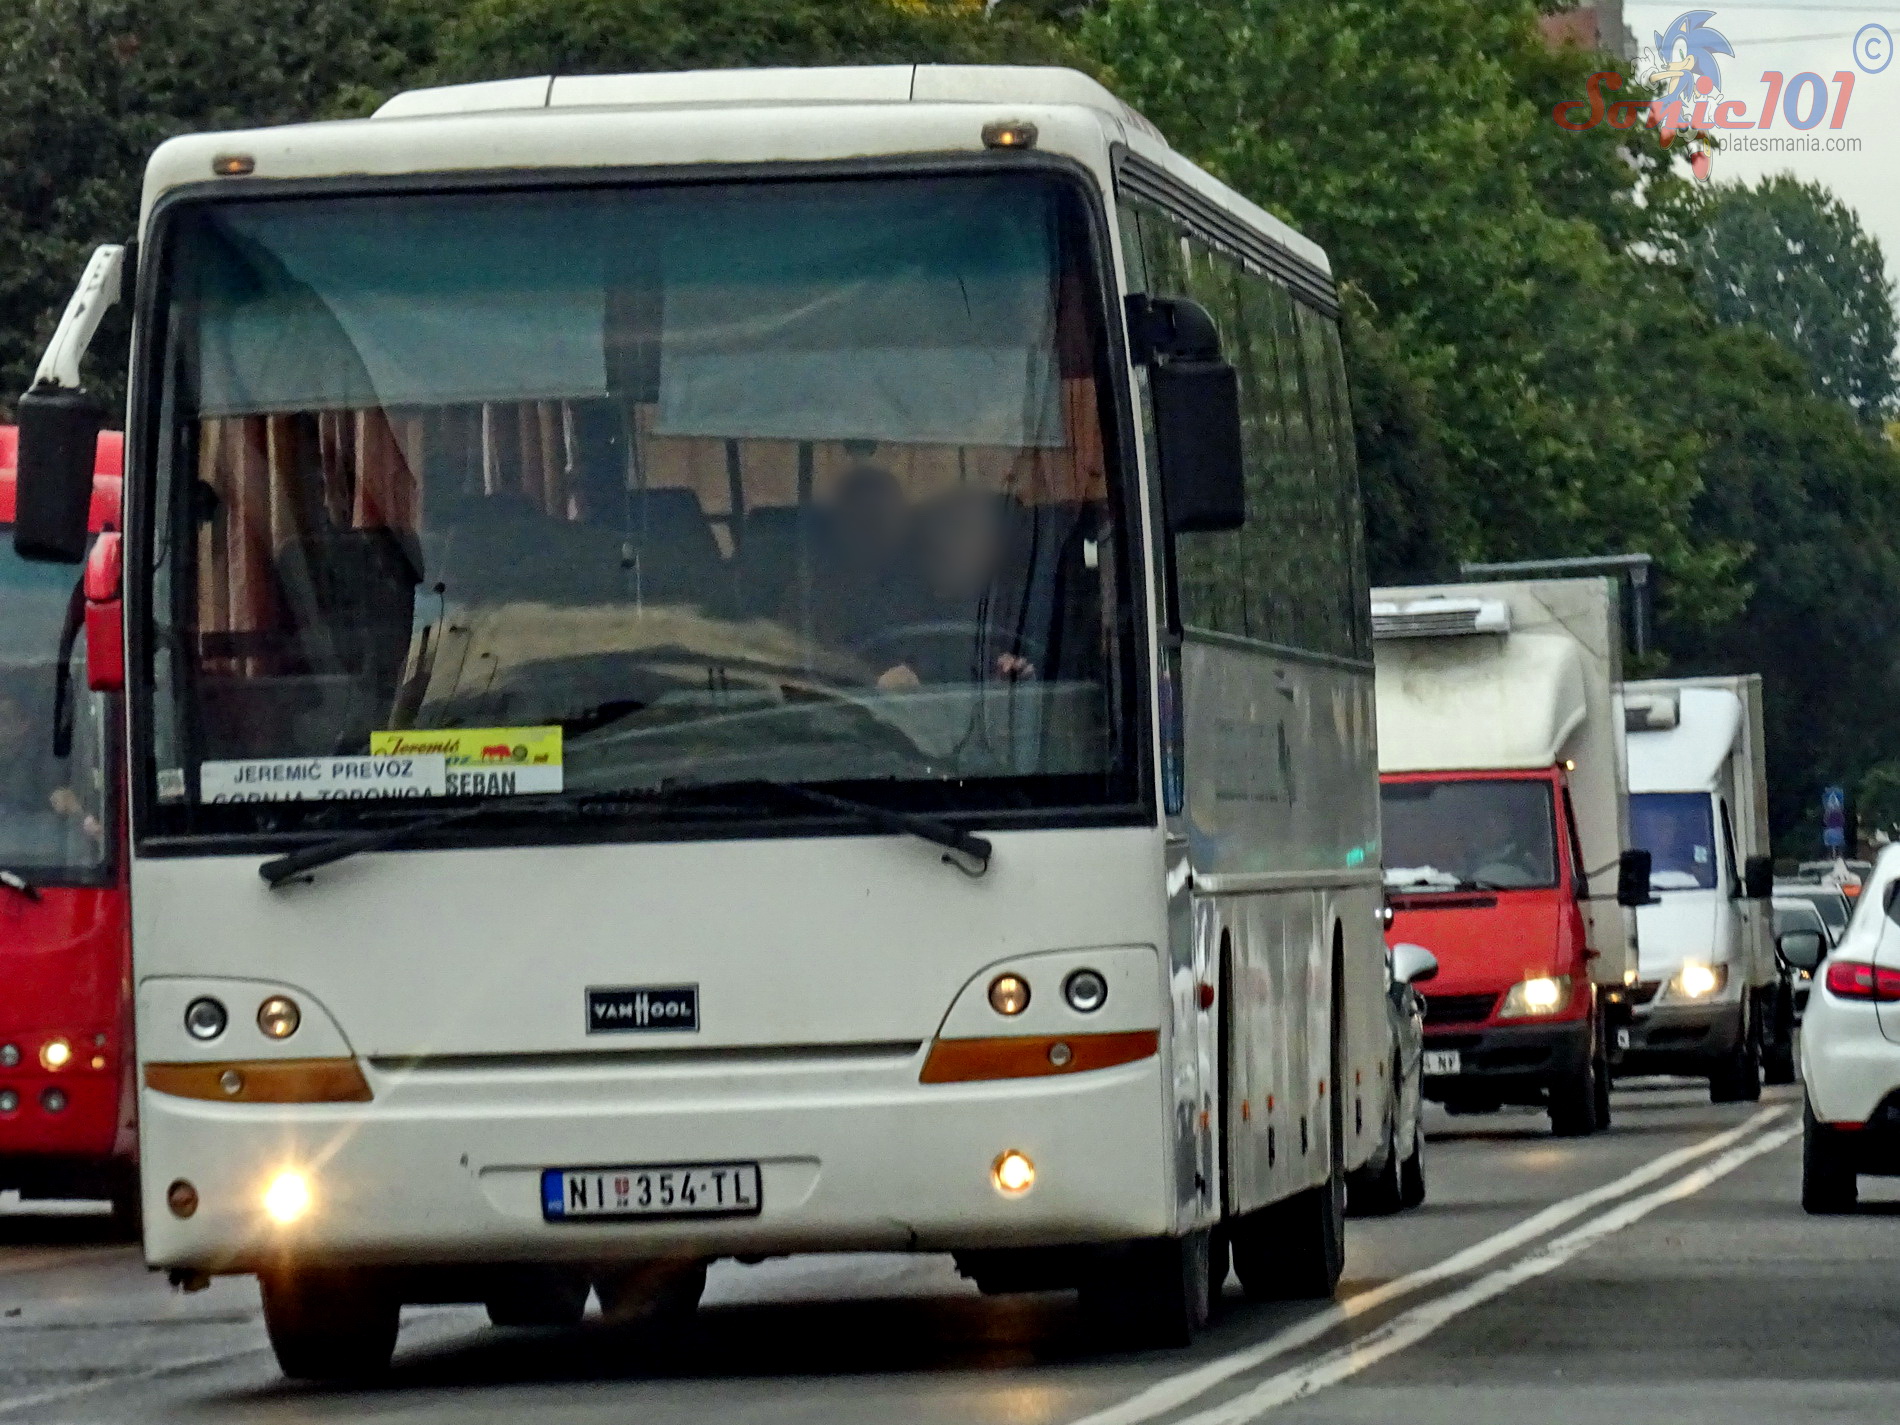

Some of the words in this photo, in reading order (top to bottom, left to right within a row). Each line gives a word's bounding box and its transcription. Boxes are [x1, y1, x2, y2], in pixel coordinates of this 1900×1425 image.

[233, 759, 322, 784] JEREMIĆ
[331, 760, 414, 780] PREVOZ
[569, 1176, 604, 1209] NI
